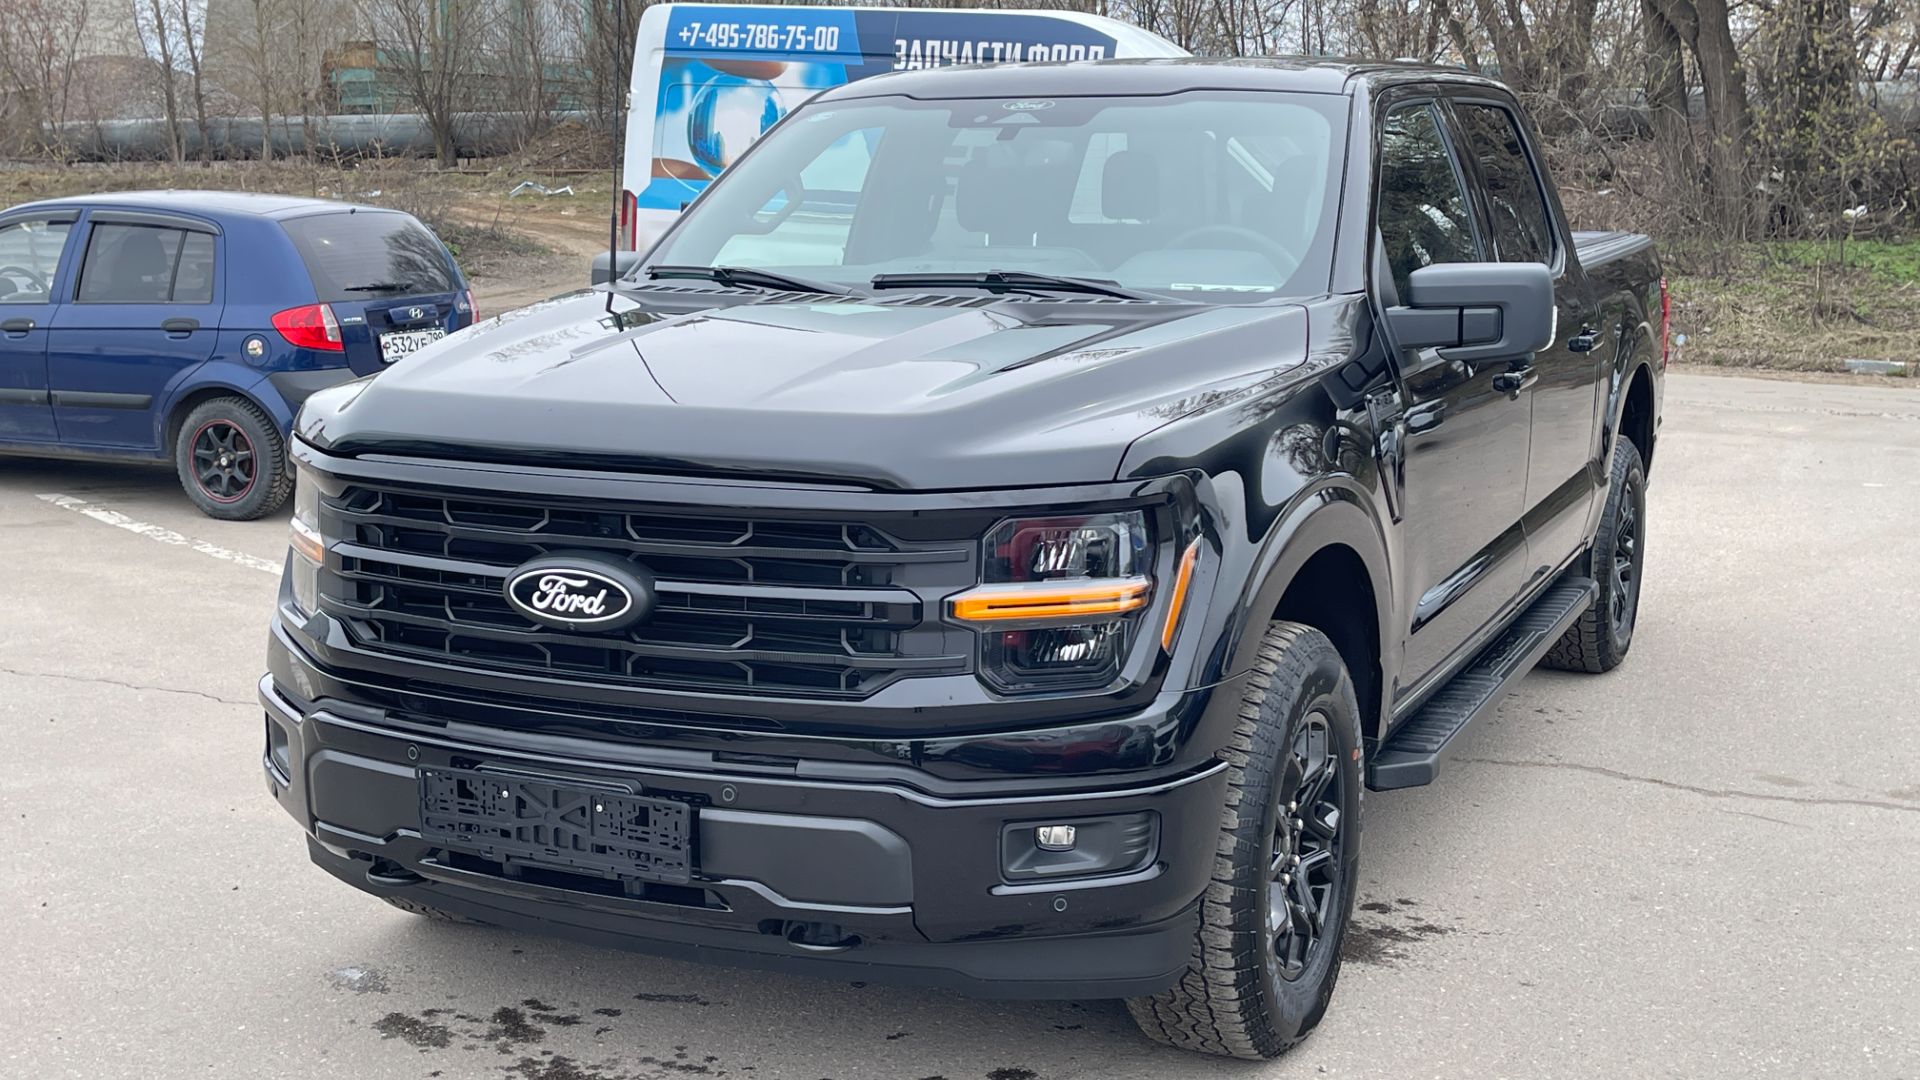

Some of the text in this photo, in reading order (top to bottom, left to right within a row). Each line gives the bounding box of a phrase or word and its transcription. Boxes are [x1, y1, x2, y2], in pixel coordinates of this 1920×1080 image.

[678, 22, 839, 51] +7-495-786-75-00
[894, 39, 1022, 70] ЗАПЧАСТИ
[532, 574, 607, 615] Ford
